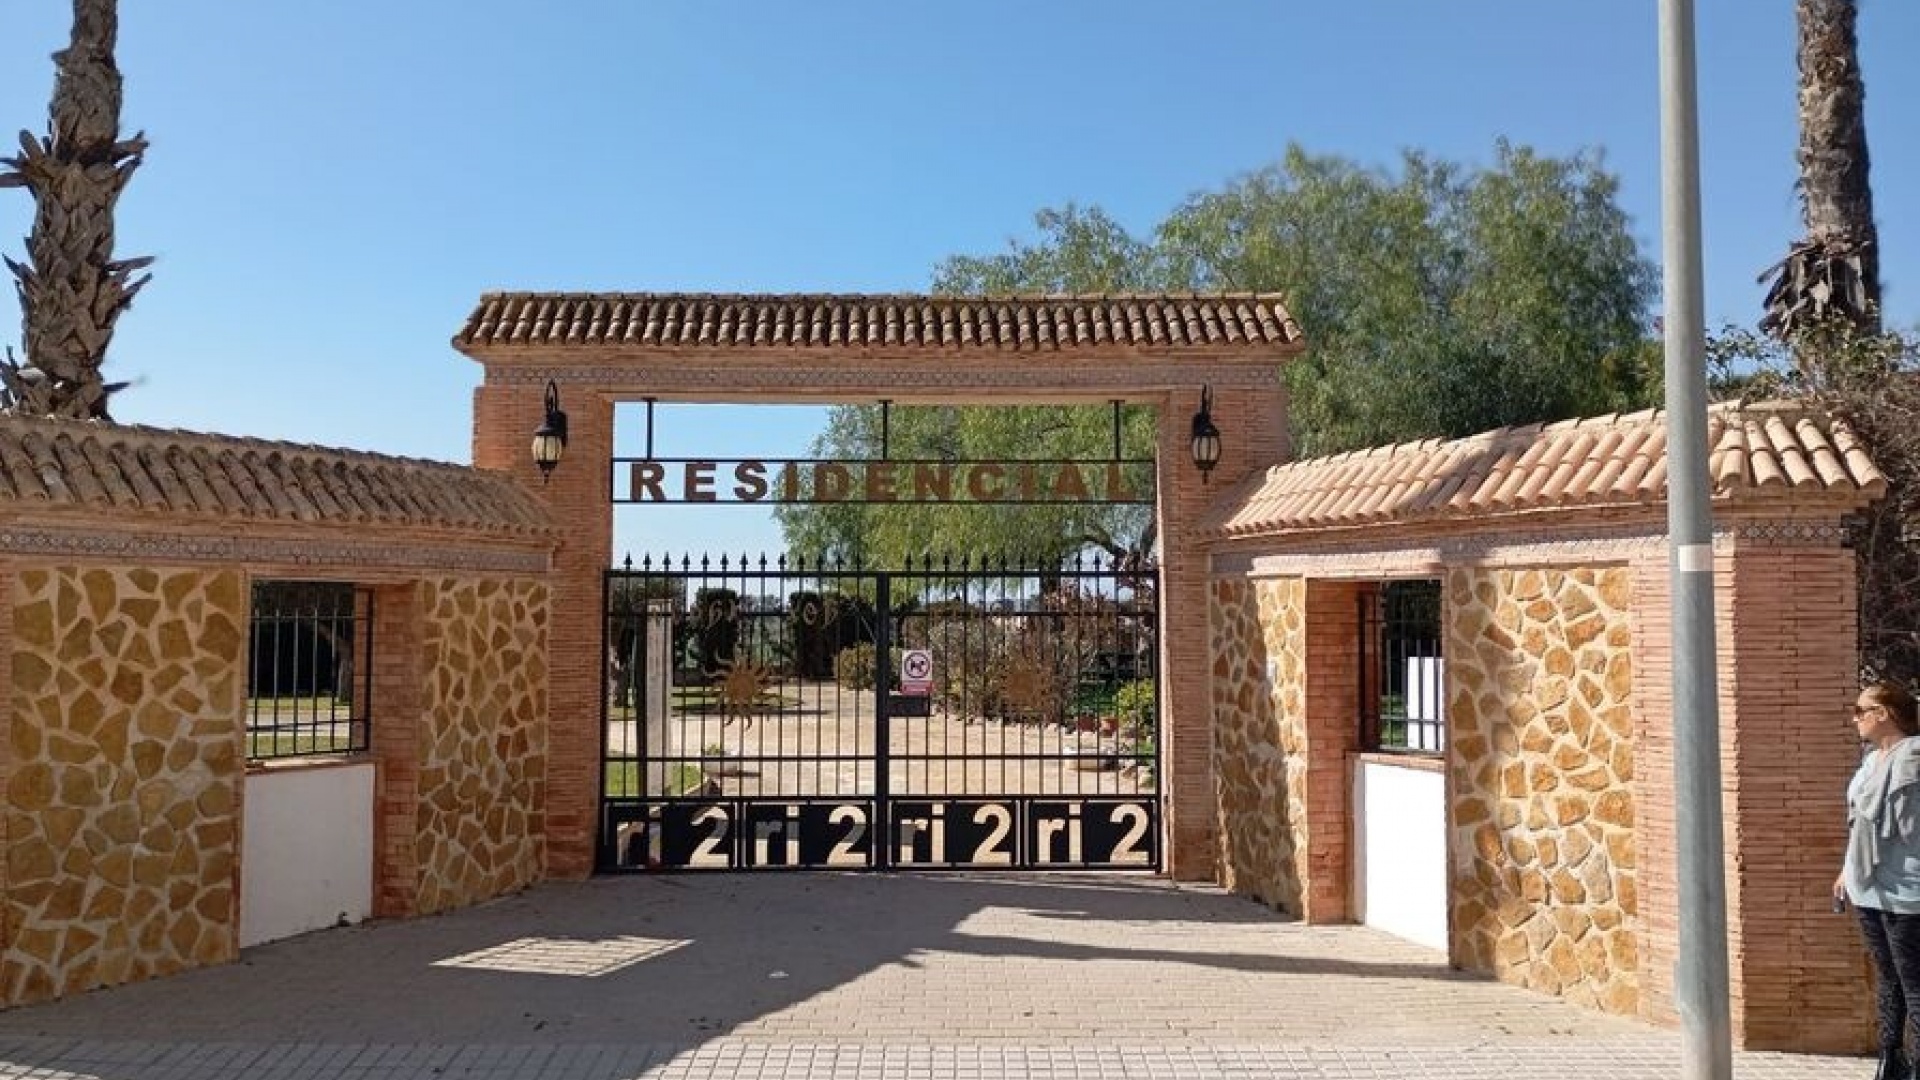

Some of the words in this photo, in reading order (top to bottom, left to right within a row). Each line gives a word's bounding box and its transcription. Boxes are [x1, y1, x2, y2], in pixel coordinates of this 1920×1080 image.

[630, 461, 1136, 501] RESIDENCIAL
[690, 806, 730, 869] 2
[755, 804, 799, 866] ri
[826, 805, 867, 867] 2
[901, 803, 944, 865] ri
[972, 803, 1011, 865] 2
[1038, 802, 1082, 865] ri
[1110, 803, 1149, 865] 2
